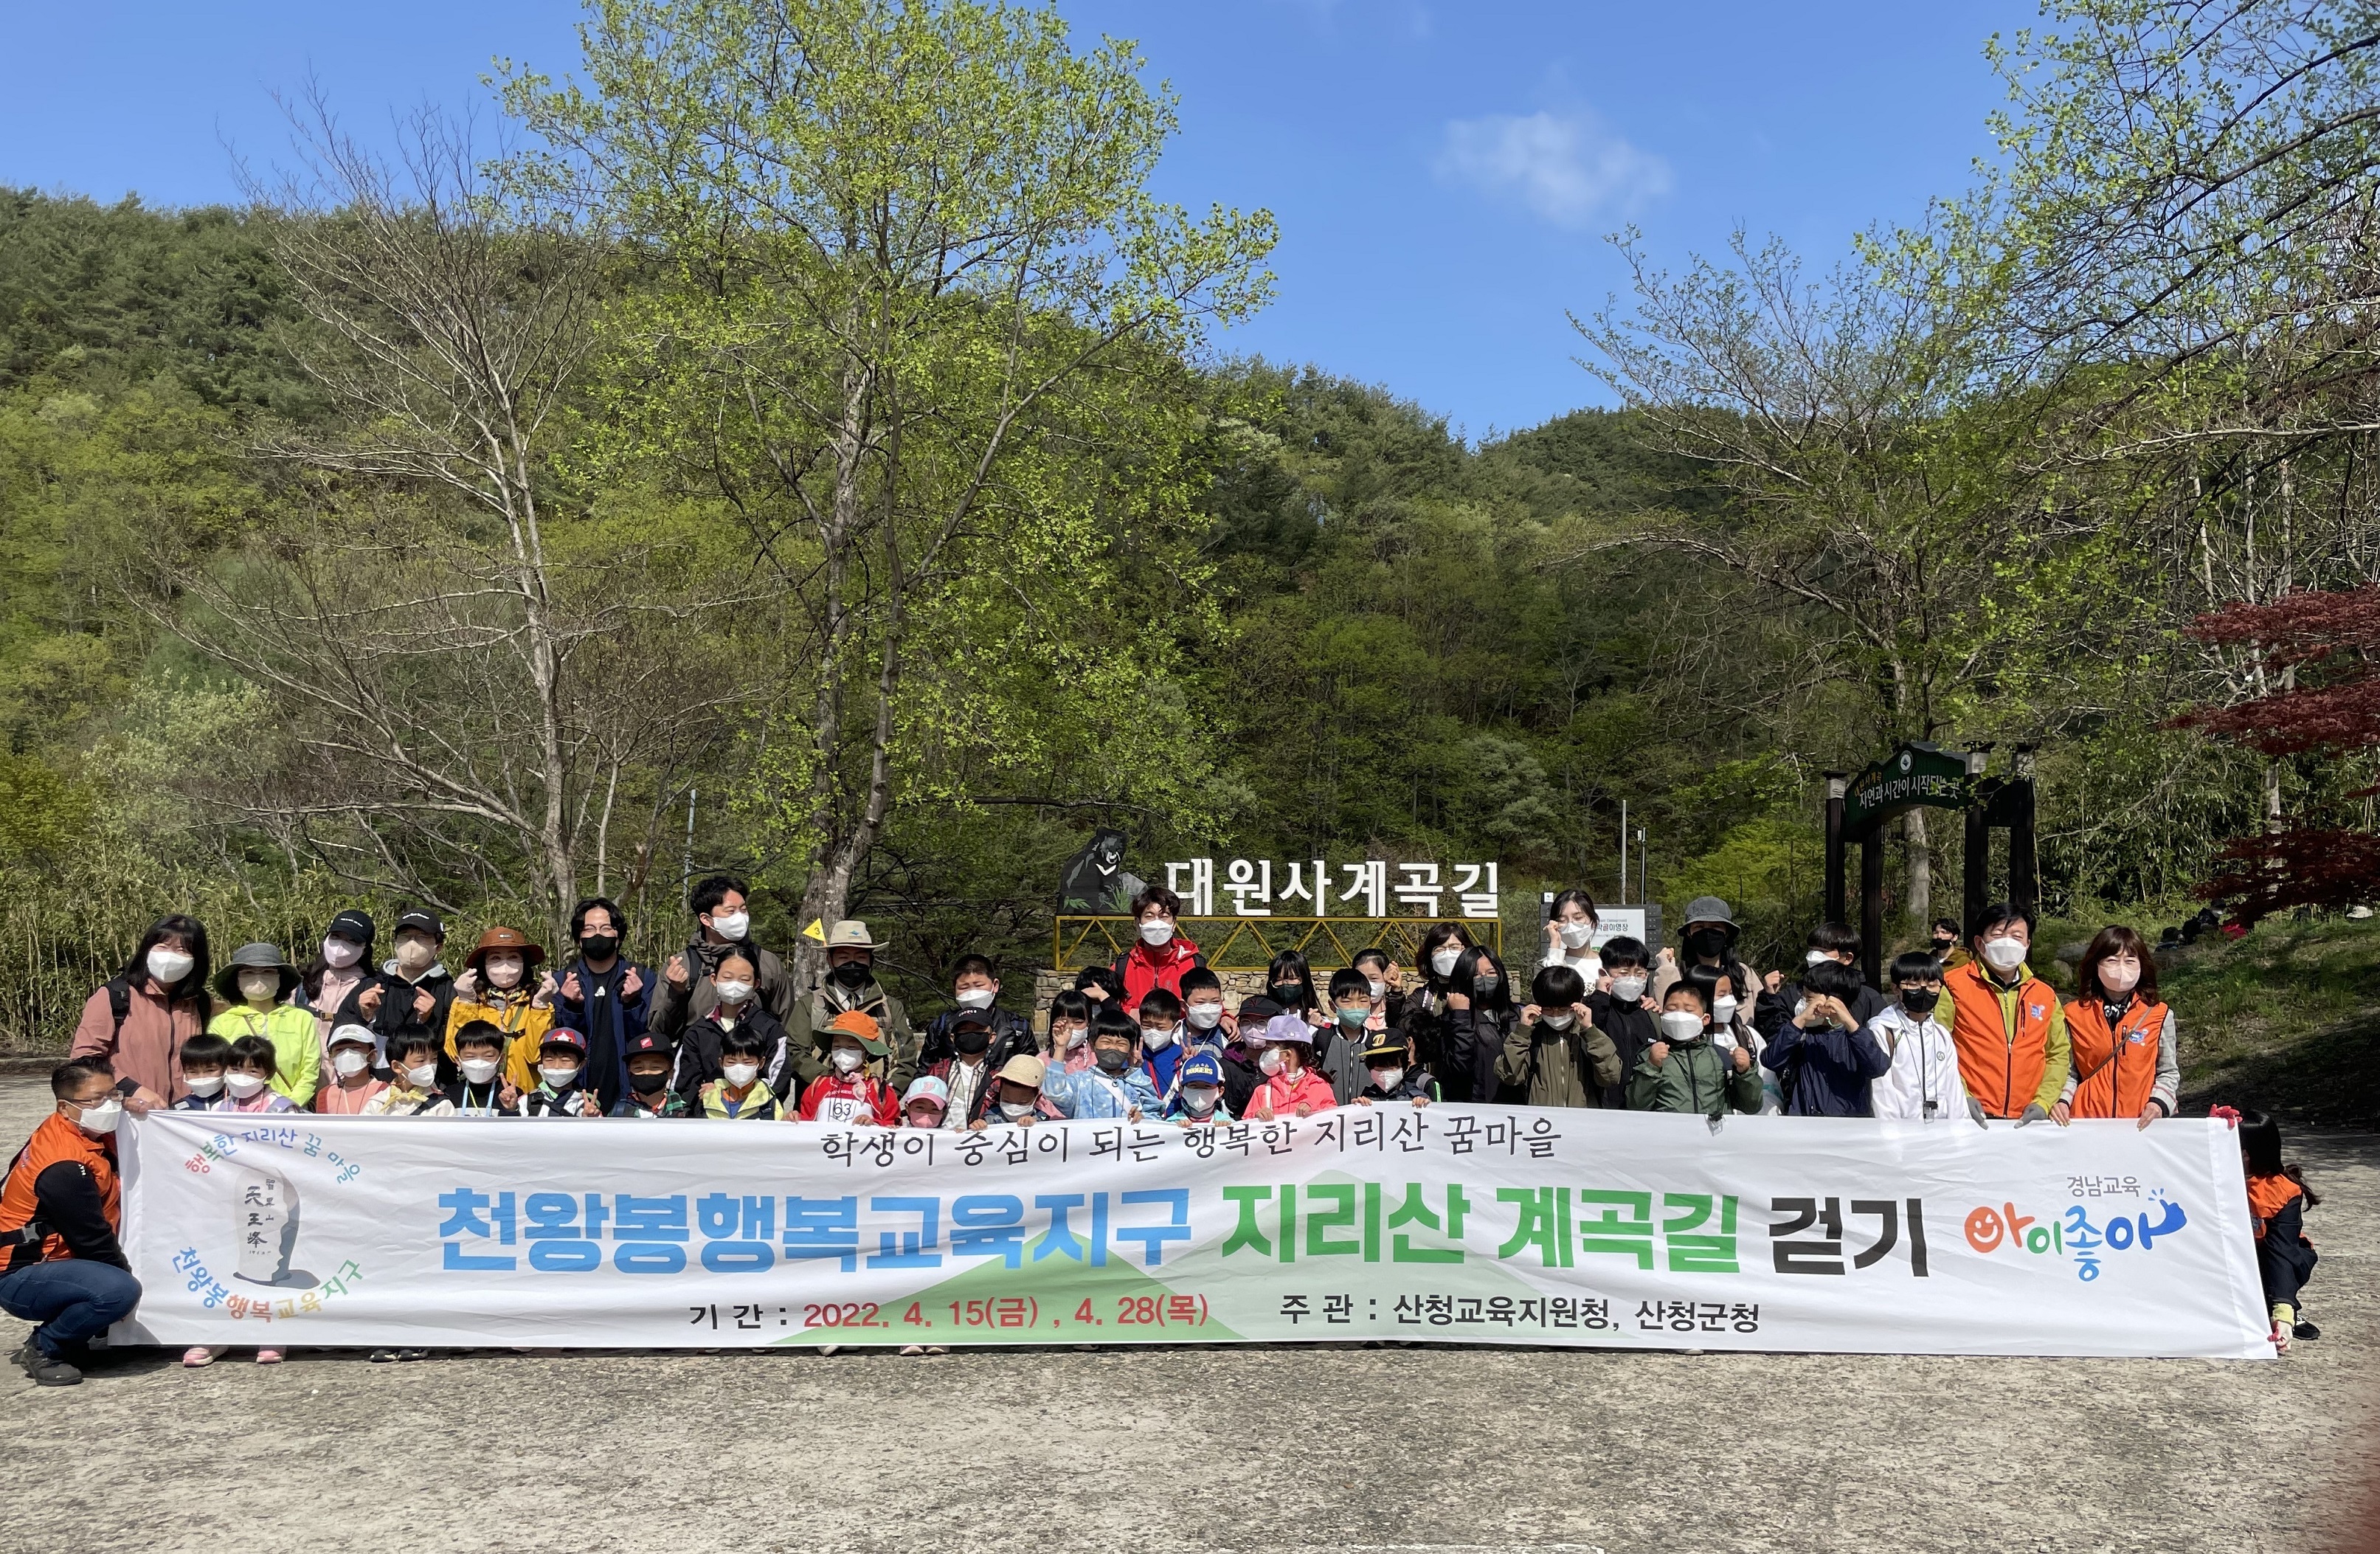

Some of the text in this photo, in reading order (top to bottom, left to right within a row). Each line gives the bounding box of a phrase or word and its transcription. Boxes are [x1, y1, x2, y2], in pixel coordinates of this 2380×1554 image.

[1859, 784, 1883, 809] 자연과
[1884, 776, 1909, 801] 시간이
[1165, 858, 1498, 917] 대원사계곡길
[814, 927, 820, 935] 3
[834, 1102, 851, 1116] 63
[185, 1127, 361, 1184] 행복한 지리산 꿈 마을
[821, 1111, 1562, 1167] 학생이 중심이 되는 행복한 지리산 꿈마을
[2066, 1175, 2141, 1198] 경남교육
[438, 1182, 1930, 1278] 천왕봉행복교육지구 지리산 계곡길 걷기
[1964, 1198, 2187, 1282] 아이좋아
[690, 1304, 719, 1330] 기
[733, 1304, 764, 1330] 간
[804, 1302, 890, 1328] 2022.
[904, 1302, 933, 1327] 4.
[949, 1296, 1039, 1328] 15(금)
[1075, 1299, 1103, 1326] 4.
[1118, 1294, 1208, 1326] 28(목)
[1280, 1294, 1312, 1325] 주
[1323, 1294, 1355, 1325] 관
[1393, 1294, 1620, 1332] 산청교육지원청,
[1635, 1301, 1760, 1334] 산청군청
